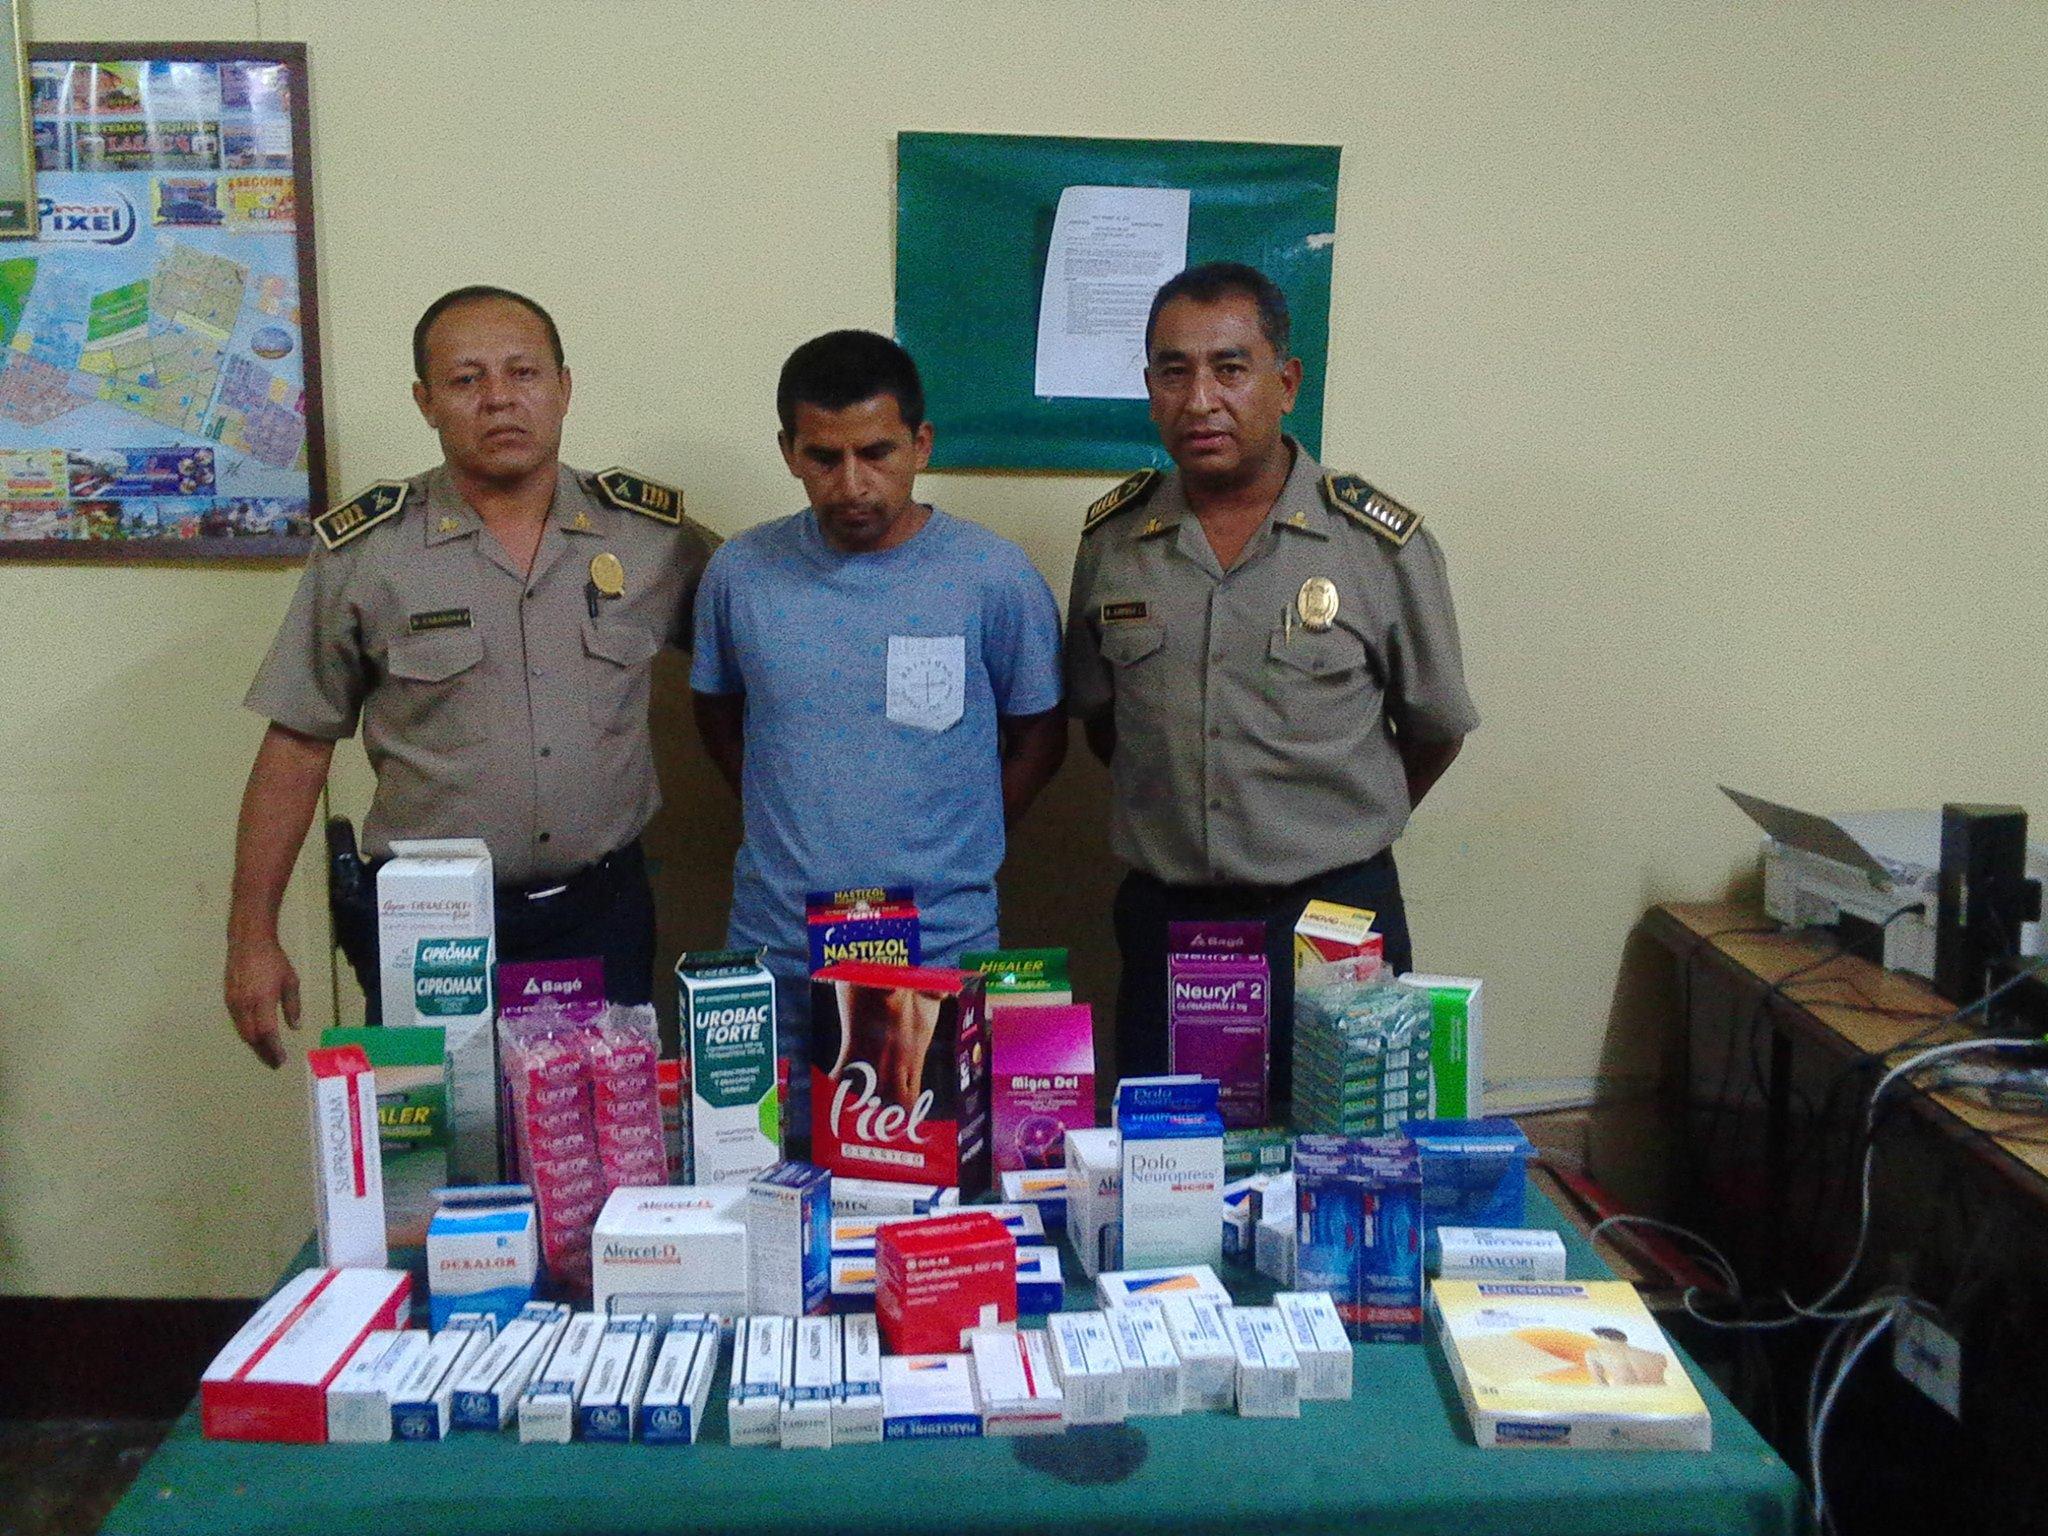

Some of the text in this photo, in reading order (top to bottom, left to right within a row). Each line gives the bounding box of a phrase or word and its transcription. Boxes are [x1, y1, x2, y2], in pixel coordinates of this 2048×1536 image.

[824, 938, 909, 961] NASTIZOL
[416, 976, 484, 997] CIPROMAX
[1176, 982, 1262, 1003] Neuryl 2
[696, 1004, 769, 1030] UROBAC
[706, 1023, 761, 1046] FORTE
[830, 1061, 934, 1144] Piel
[1132, 1153, 1177, 1172] Dolo
[1132, 1169, 1215, 1184] Neuropress
